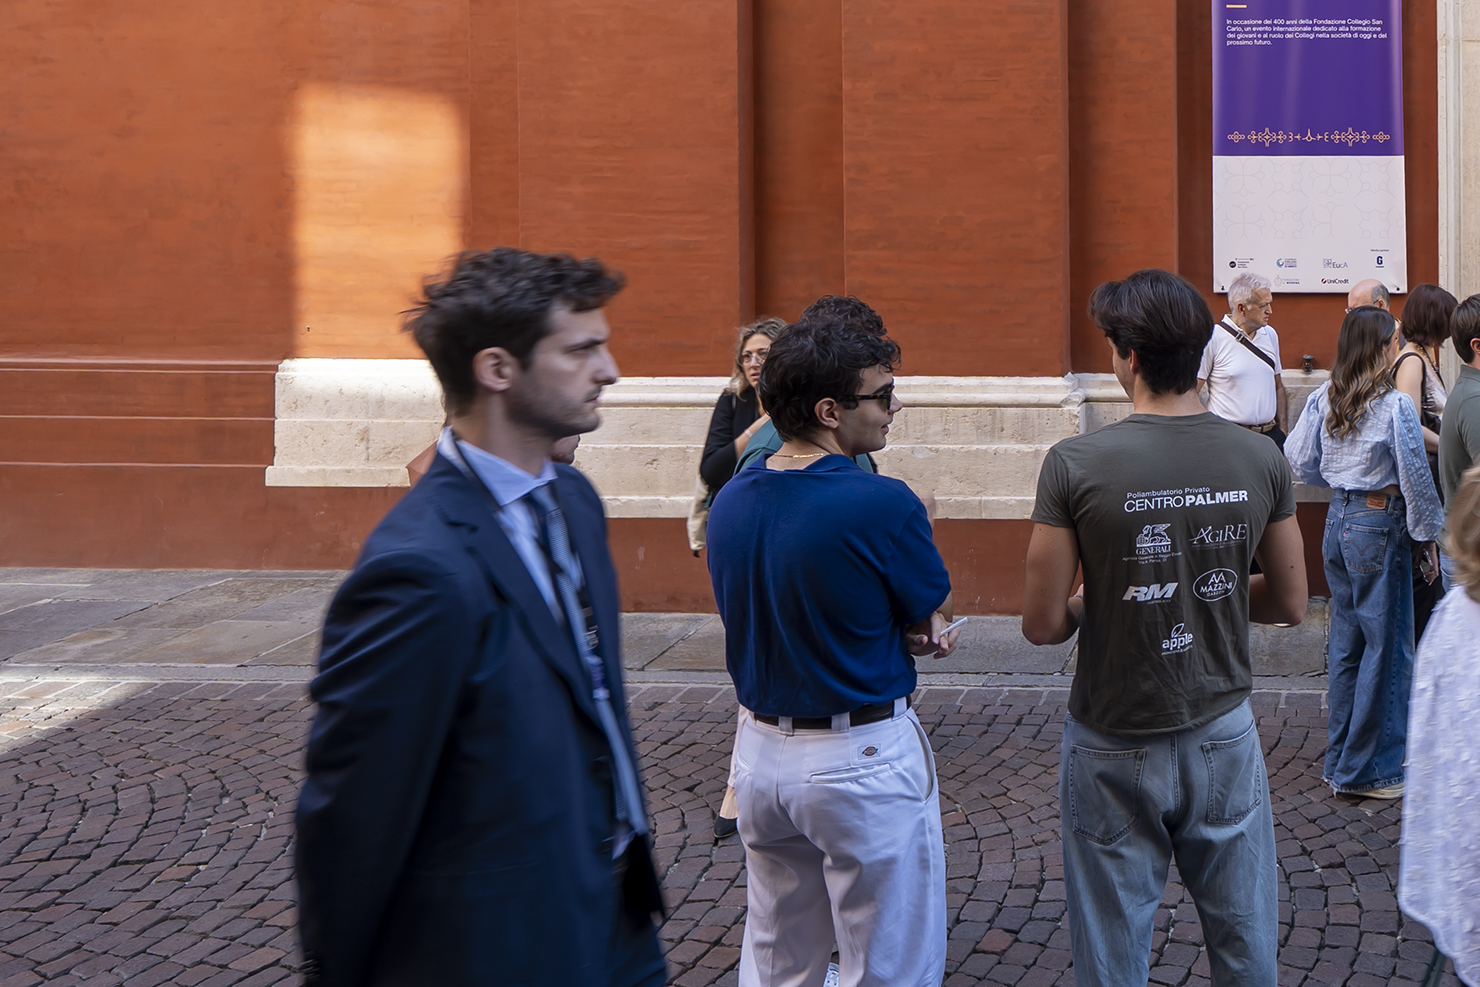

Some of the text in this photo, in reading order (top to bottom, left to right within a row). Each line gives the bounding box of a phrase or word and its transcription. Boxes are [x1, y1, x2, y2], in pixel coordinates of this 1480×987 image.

[1127, 486, 1210, 499] Poliambulatorio Privato
[1136, 545, 1171, 555] GENERALI
[1122, 582, 1179, 602] RM
[1199, 582, 1232, 593] MAZZINI
[1162, 633, 1193, 650] apple
